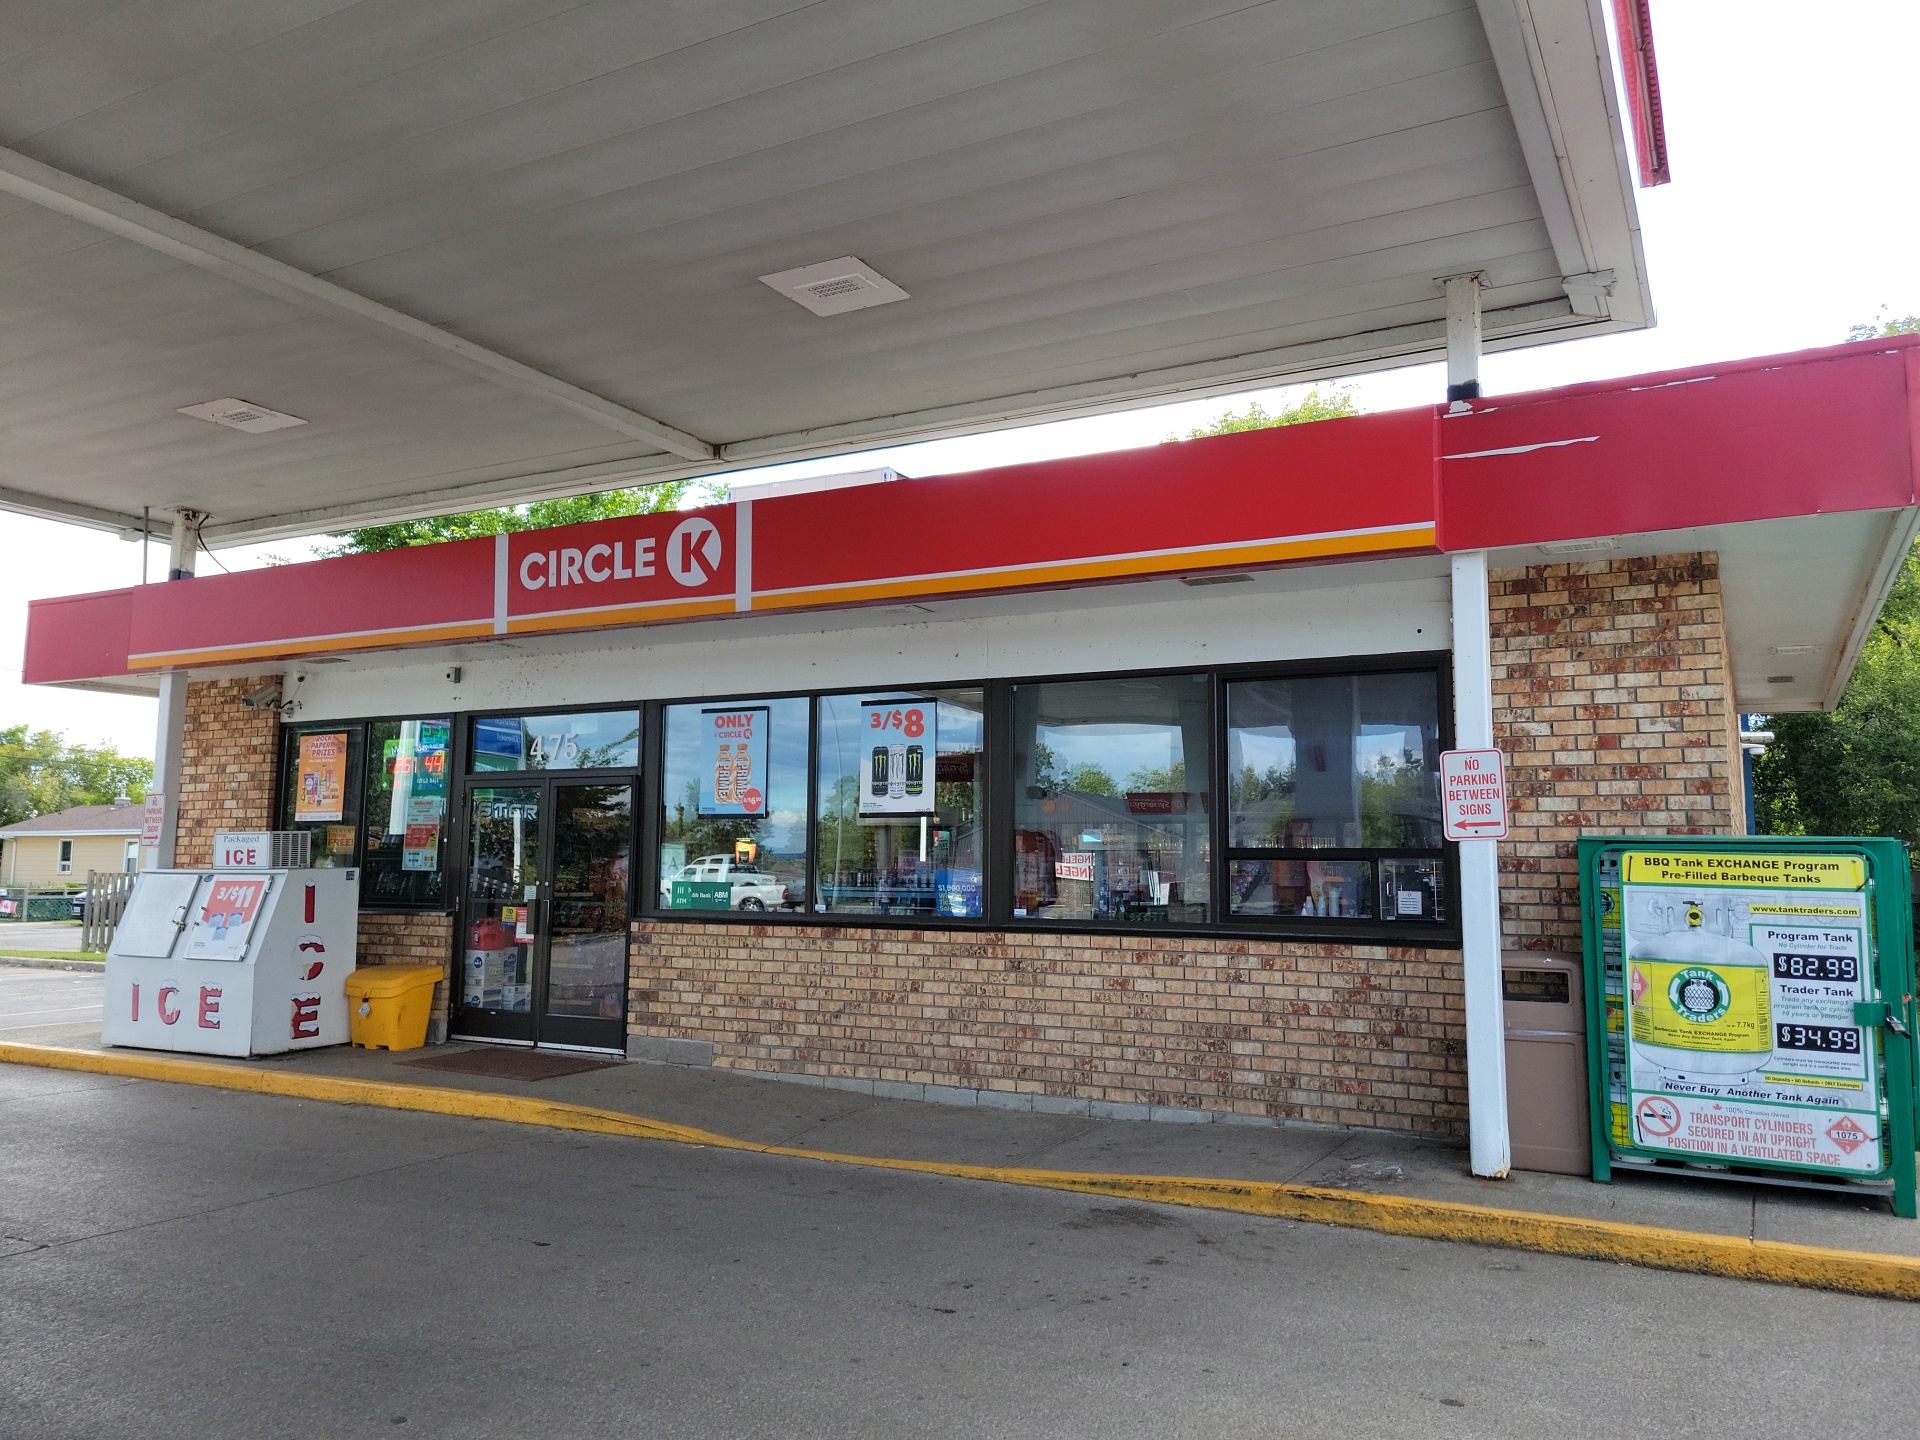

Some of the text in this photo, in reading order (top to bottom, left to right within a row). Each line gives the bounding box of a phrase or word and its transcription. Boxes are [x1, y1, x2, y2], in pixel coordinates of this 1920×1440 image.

[520, 527, 719, 590] CIRCLE K
[714, 714, 753, 728] ONLY
[871, 709, 925, 738] 3/$8
[744, 728, 752, 739] K
[312, 749, 336, 757] PRIZES
[530, 733, 579, 760] 475
[1464, 760, 1479, 771] NO
[718, 763, 730, 797] PRIME
[736, 763, 748, 796] PRIME
[1450, 773, 1496, 786] PARKING
[1449, 788, 1500, 801] BETWEEN
[146, 807, 163, 815] PARKING
[473, 801, 538, 820] STER
[1459, 804, 1491, 815] SIGNS
[223, 835, 260, 843] Packaged
[328, 838, 354, 846] FREE!
[225, 849, 256, 865] ICE
[1644, 857, 1839, 872] BBQ Tank EXCHANGE Program
[1662, 870, 1821, 883] Pre-Filled Barbeque Tanks
[713, 891, 728, 899] ABM
[937, 884, 976, 894] $1,000,000
[216, 886, 255, 908] 3/$11
[1752, 906, 1857, 915] www.tanktraders.com
[1768, 930, 1853, 943] Program Tank
[1789, 942, 1816, 950] Cylinder
[1777, 955, 1854, 978] $82.99
[1680, 969, 1714, 980] Tank
[1779, 984, 1854, 997] Trader Tank
[131, 977, 222, 1030] ICE
[1829, 1006, 1854, 1014] cylinde
[1676, 1005, 1726, 1023] Traders
[1820, 1012, 1849, 1020] younger
[1736, 1021, 1755, 1029] 7.7kg
[1781, 1026, 1857, 1050] $34.99
[1665, 1082, 1839, 1106] Never Buy Another Tank Again
[1725, 1106, 1743, 1114] 100%
[1690, 1112, 1813, 1135] TRANSPORT CYLINDERS
[1688, 1125, 1816, 1149] SECURED IN AN UPRIGHT
[1836, 1131, 1858, 1140] 1075
[1668, 1136, 1840, 1166] POSITION IN A VENTILATED SPACE
